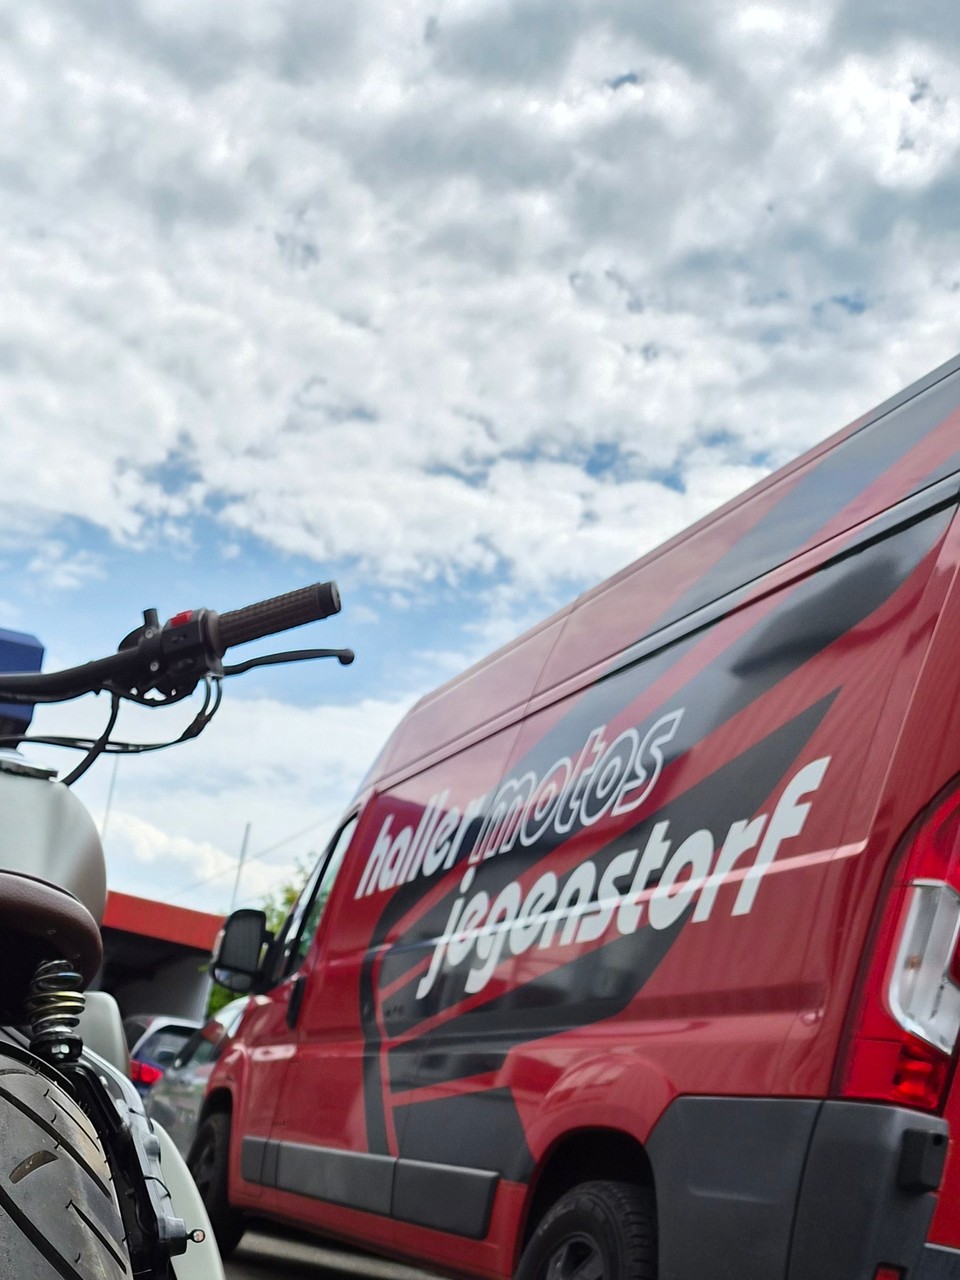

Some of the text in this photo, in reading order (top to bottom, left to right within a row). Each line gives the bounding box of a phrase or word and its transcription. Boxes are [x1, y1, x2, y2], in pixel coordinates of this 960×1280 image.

[355, 708, 685, 899] haller motos
[415, 756, 831, 1000] jegenstorf
